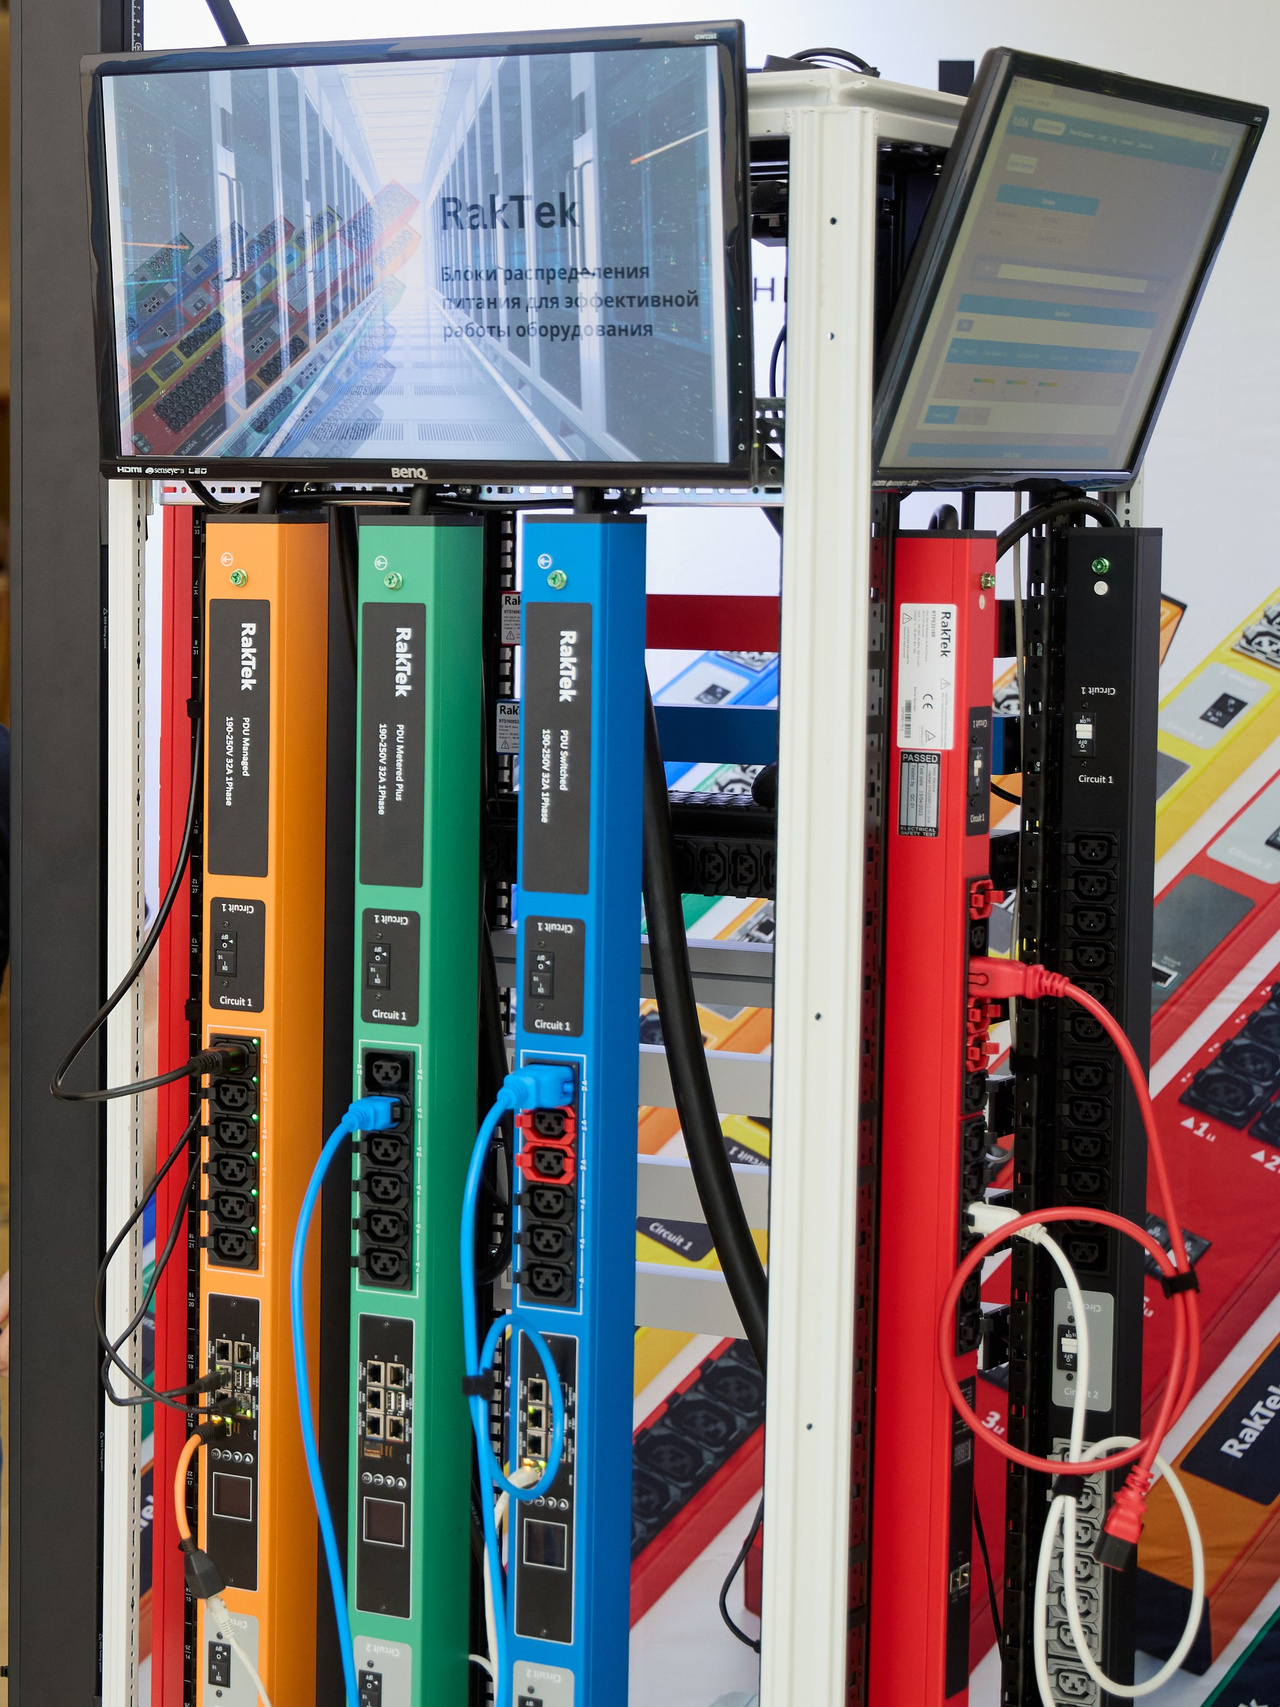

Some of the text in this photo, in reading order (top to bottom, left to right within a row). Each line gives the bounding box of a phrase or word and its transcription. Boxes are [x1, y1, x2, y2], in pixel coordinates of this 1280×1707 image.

[441, 192, 580, 230] RakTek
[441, 265, 650, 285] Блоки распределения
[442, 290, 699, 316] питания для эффективной
[443, 322, 653, 342] работы оборудования
[940, 612, 952, 658] RakTek
[241, 622, 257, 691] RakTek
[395, 627, 412, 698] RakTek
[559, 630, 577, 703] RakTek
[1081, 686, 1116, 696] Circuit 1
[226, 716, 234, 756] 190-250V
[241, 717, 250, 777] PDU Managed
[396, 724, 404, 802] PDU Metered Plus
[560, 730, 568, 792] PDU Switched
[902, 754, 938, 763] PASSED
[378, 723, 387, 816] 190-250V 32A 1Phase
[540, 728, 550, 824] 190-250V 32A 1Phase
[1078, 774, 1114, 784] Circuit 1
[222, 904, 254, 914] Circuit 1
[374, 914, 408, 926] Circuit 1
[537, 922, 574, 934] Circuit 1
[220, 996, 252, 1006] Circuit 1
[372, 1009, 406, 1020] Circuit 1
[534, 1019, 570, 1031] Circuit 1
[729, 1146, 738, 1156] 1
[649, 1222, 693, 1251] Circuit 1
[1064, 1387, 1098, 1399] Cirt 2
[981, 1410, 1001, 1429] 3
[366, 1644, 400, 1657] Circuit 2
[526, 1669, 562, 1684] Circuit 2
